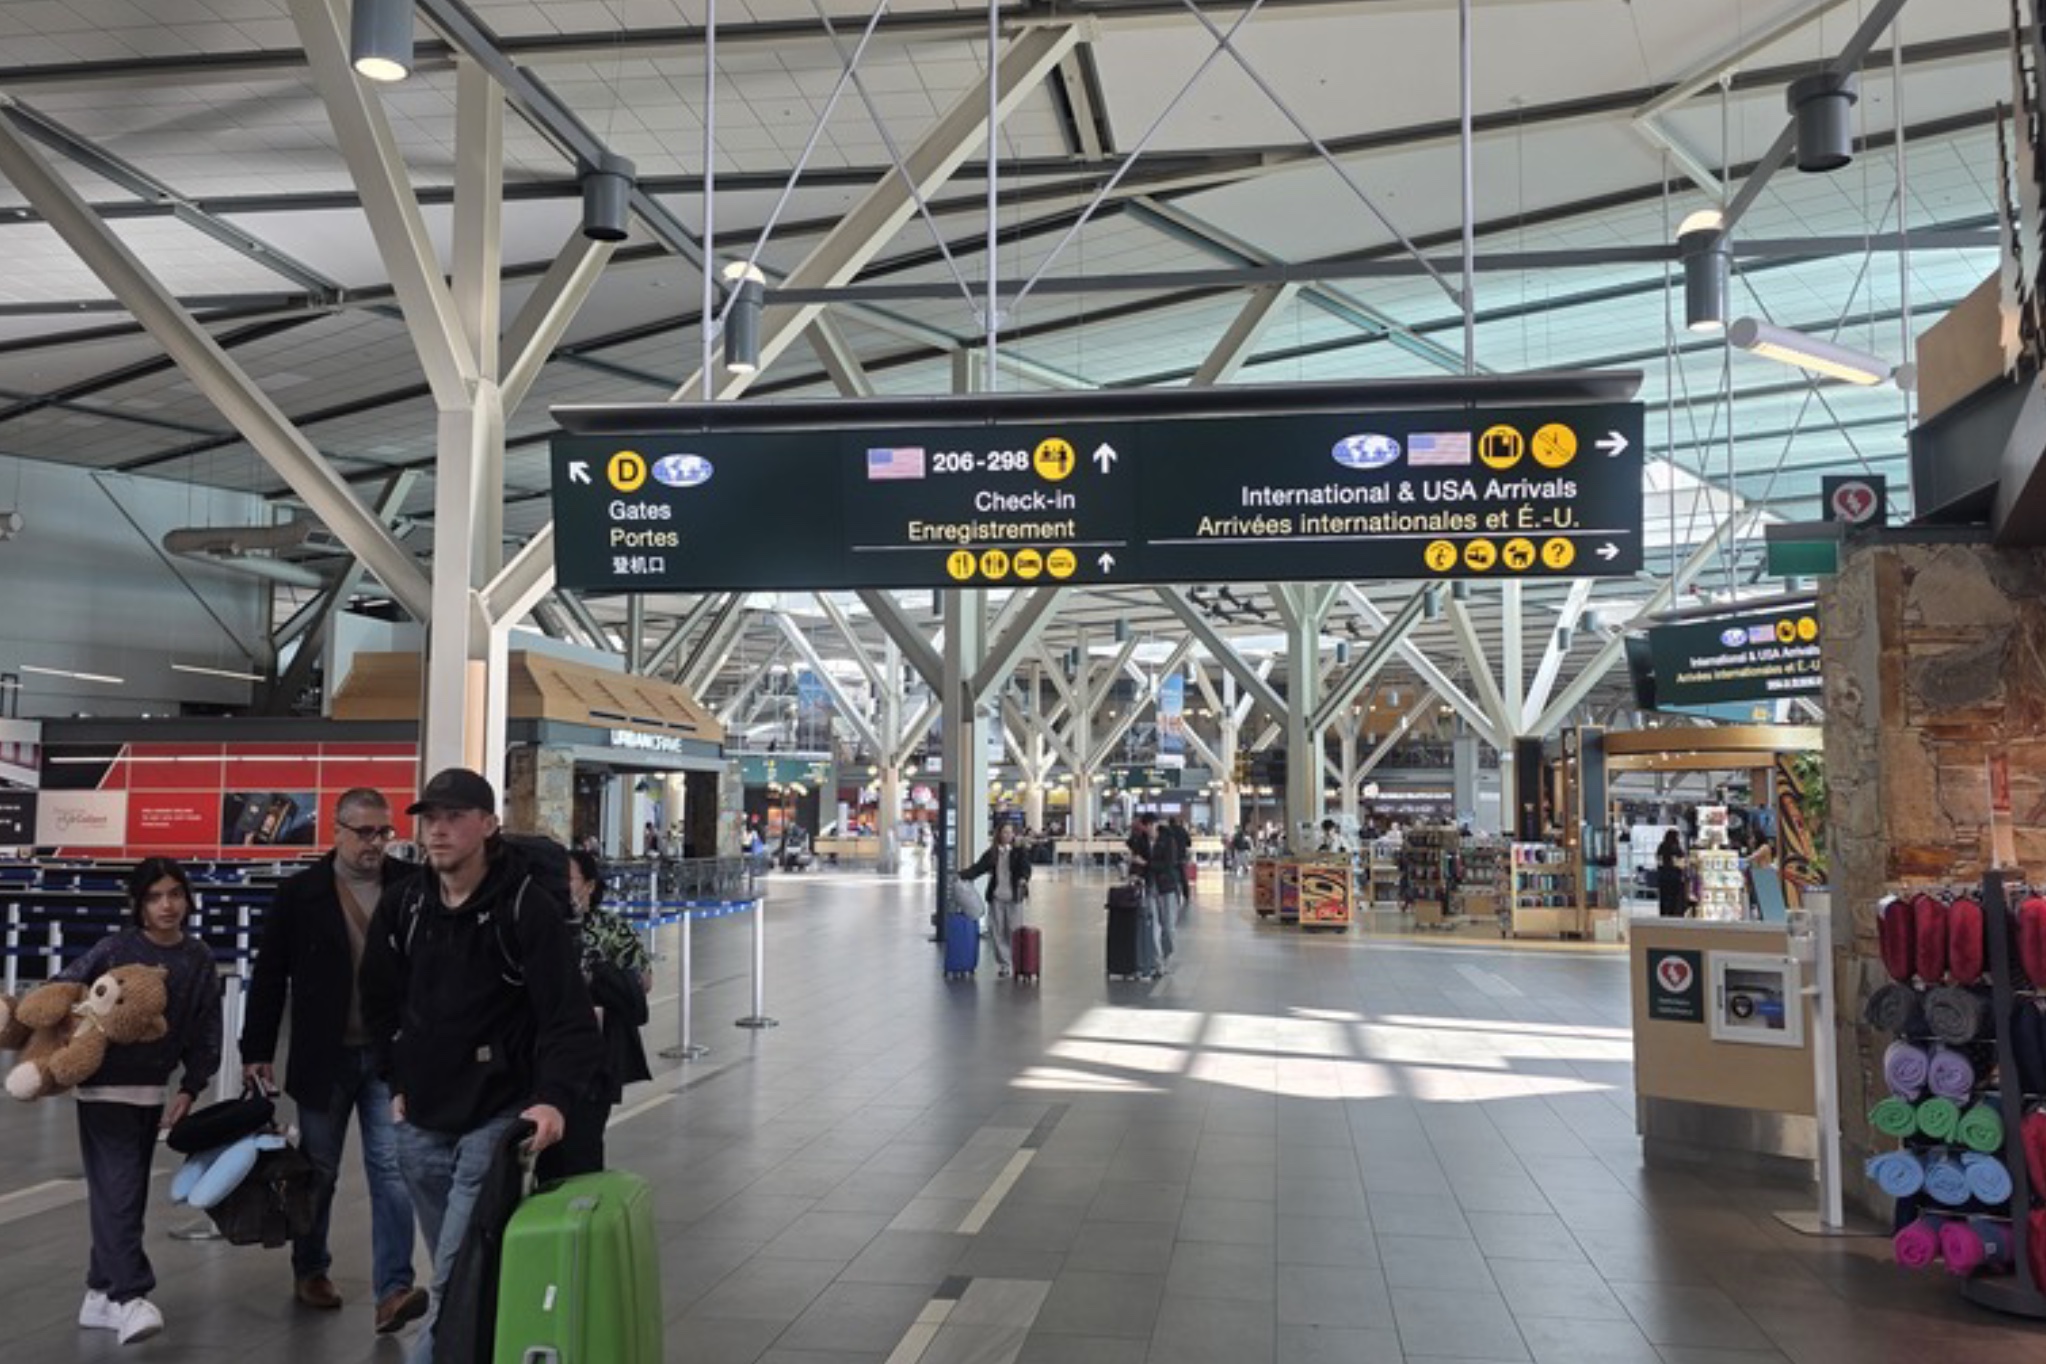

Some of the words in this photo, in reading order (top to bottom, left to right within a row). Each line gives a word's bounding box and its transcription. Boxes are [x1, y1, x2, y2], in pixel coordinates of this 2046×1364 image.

[617, 458, 638, 482] D
[933, 451, 1029, 472] 206-298
[974, 490, 1076, 511] Check-in
[1241, 482, 1390, 507] International
[1398, 480, 1416, 502] &
[1423, 480, 1477, 501] USA
[1483, 478, 1577, 500] Arrivals
[609, 500, 672, 521] Gates
[1197, 514, 1293, 536] Arrivées
[1301, 510, 1477, 535] internationales
[1486, 510, 1509, 530] et
[1518, 503, 1580, 528] É.-U.
[610, 528, 679, 548] Portes
[908, 520, 1075, 543] Enregistrement
[612, 556, 665, 575] 登机口
